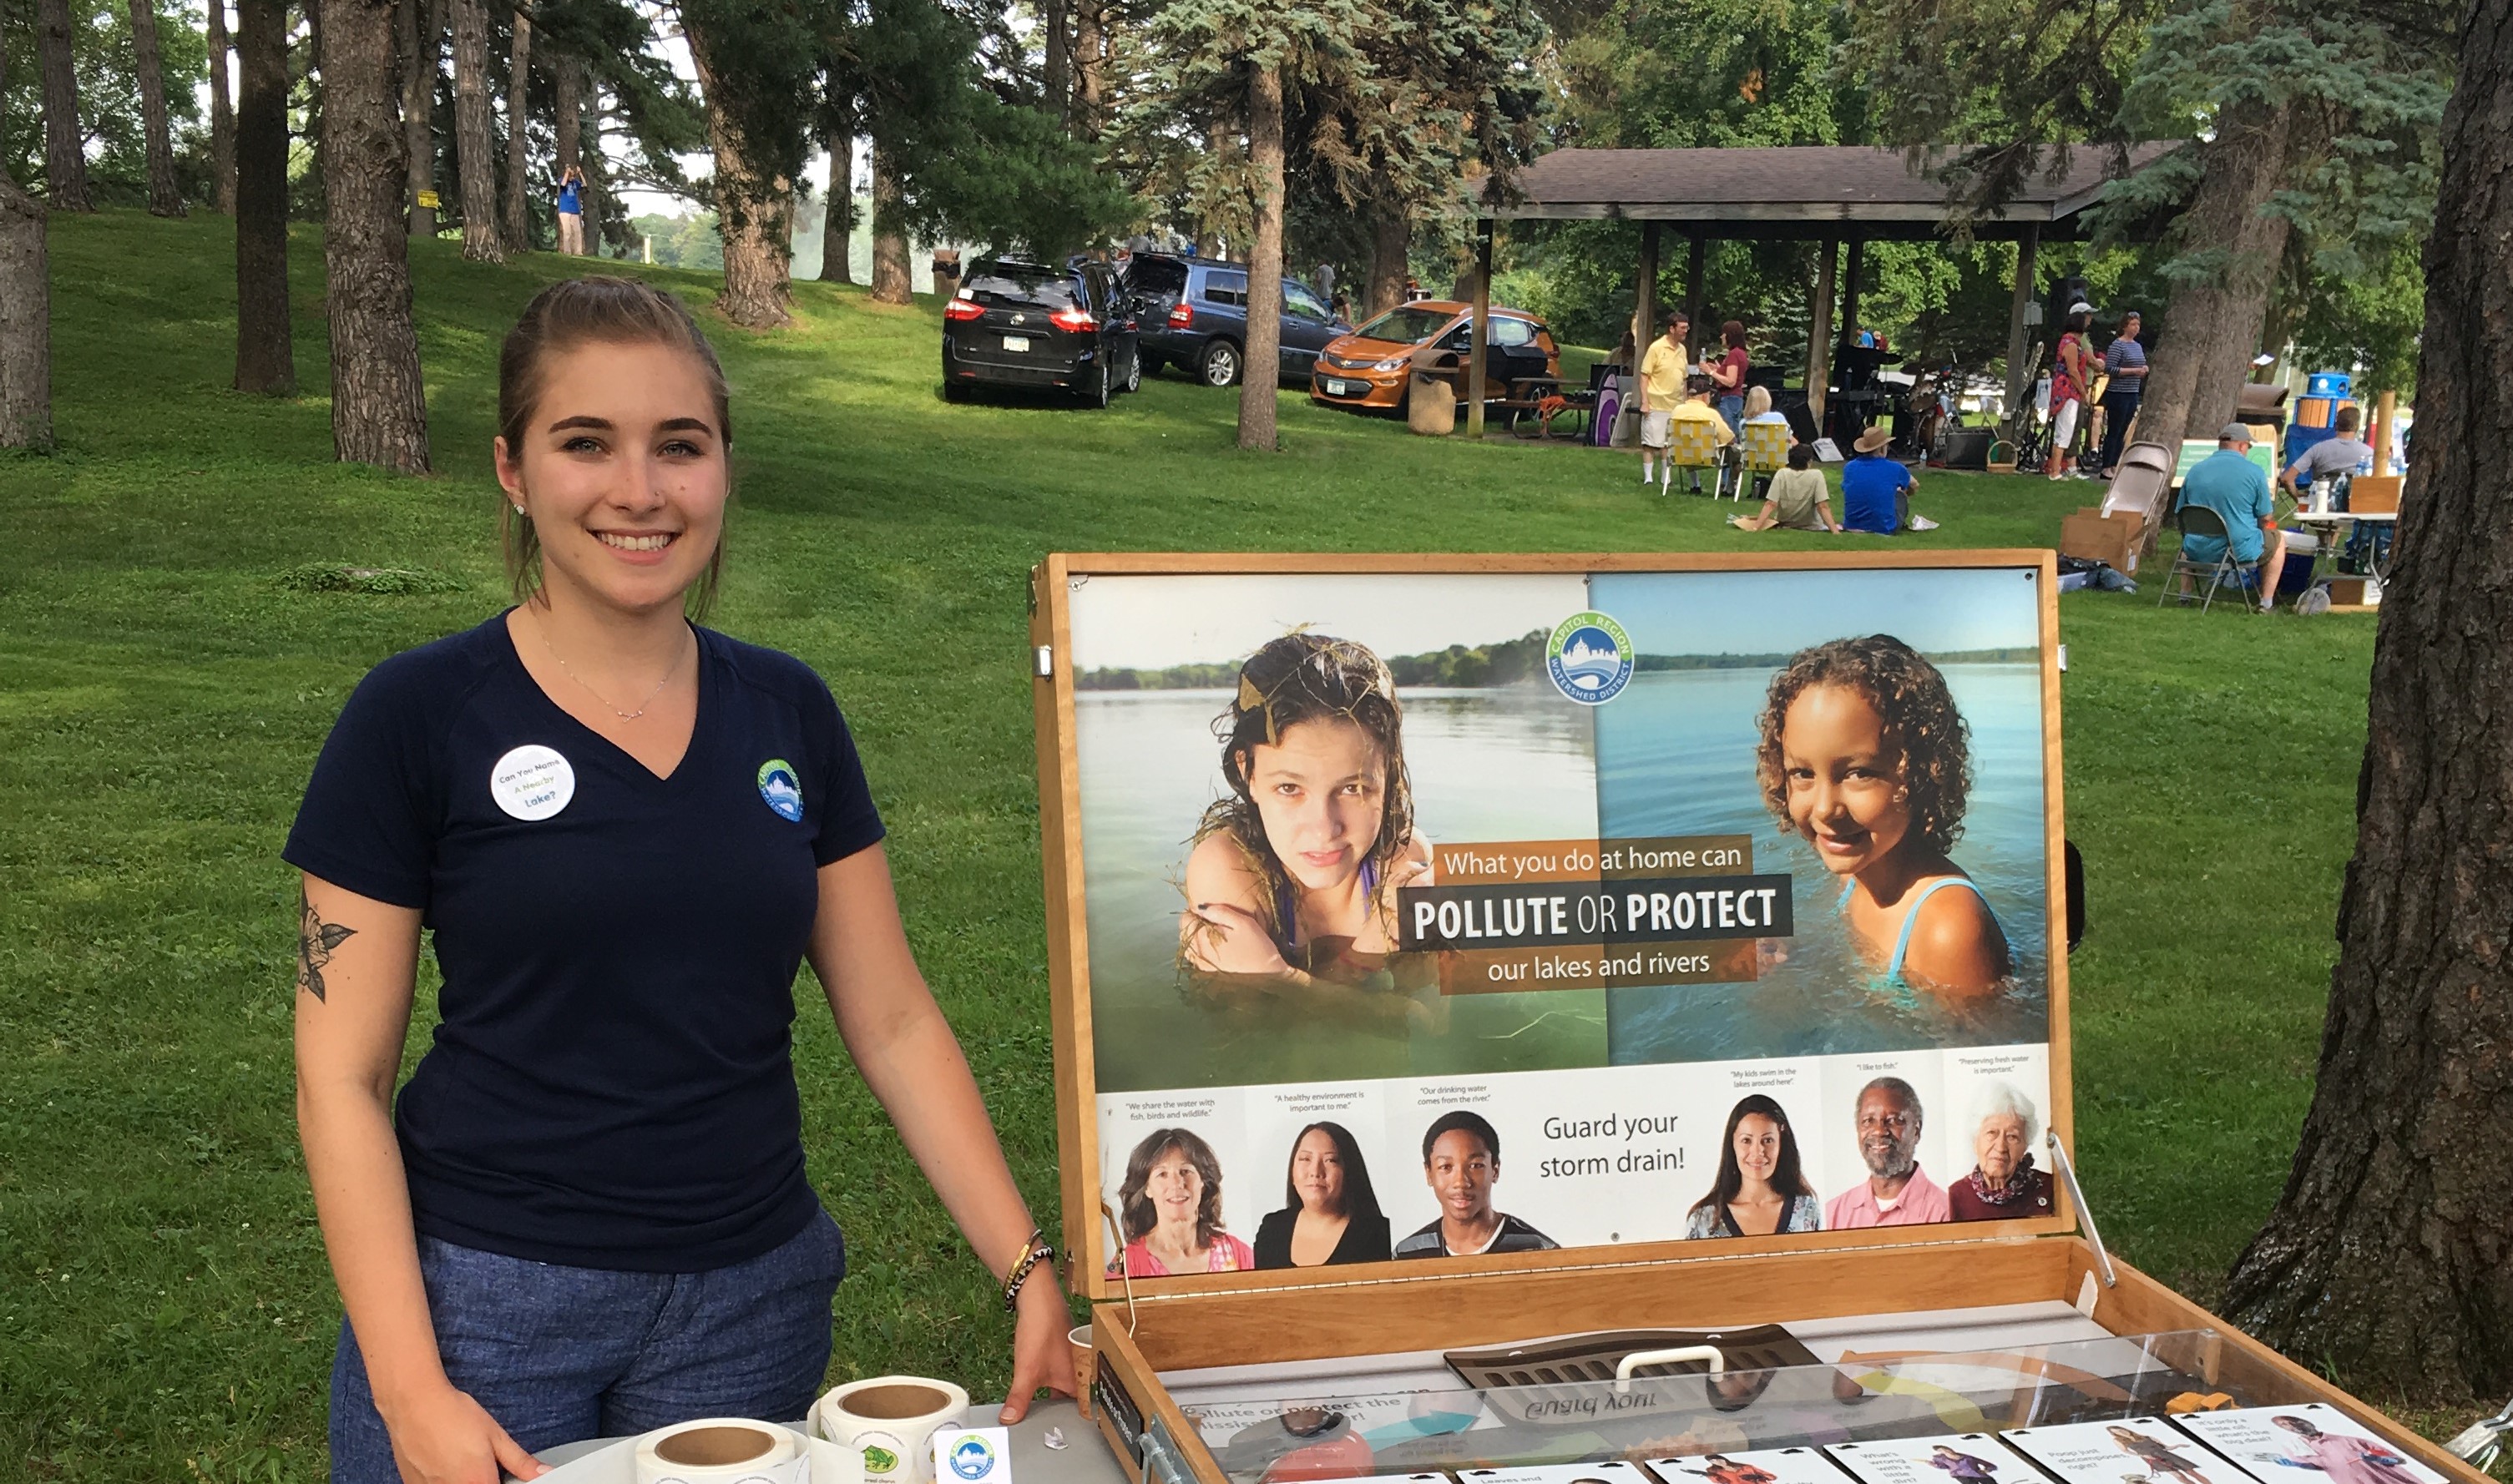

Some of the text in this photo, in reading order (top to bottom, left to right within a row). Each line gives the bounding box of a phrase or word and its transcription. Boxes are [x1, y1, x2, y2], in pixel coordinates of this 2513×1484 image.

[1551, 615, 1630, 654] CAPITOL REGION
[1551, 658, 1630, 701] WATERSHED DISTRICT
[499, 759, 560, 784] Can You Name
[523, 775, 554, 791] Nearby
[524, 790, 556, 808] Lake?
[1444, 846, 1742, 879] What you do at home can
[1413, 888, 1777, 941] POLLUTE OR PROTECT
[1487, 951, 1711, 983] our lakes and rivers
[1744, 1069, 1758, 1078] kids
[1759, 1068, 1777, 1077] swim
[1437, 1086, 1466, 1094] drinking
[1752, 1079, 1775, 1088] around
[1141, 1101, 1162, 1110] share
[1163, 1100, 1176, 1108] the
[1176, 1100, 1198, 1108] water
[1199, 1098, 1216, 1107] with
[1284, 1093, 1311, 1103] healthy
[1312, 1092, 1357, 1101] environment
[1441, 1096, 1459, 1104] from
[1459, 1095, 1471, 1103] the
[1130, 1113, 1145, 1121] fish,
[1146, 1112, 1165, 1120] birds
[1166, 1111, 1181, 1119] and
[1289, 1103, 1326, 1113] important
[1544, 1113, 1679, 1142] Guard your
[1540, 1147, 1685, 1179] storm drain!
[1260, 1407, 1282, 1416] or
[1287, 1400, 1363, 1416] protect
[1366, 1399, 1401, 1408] the
